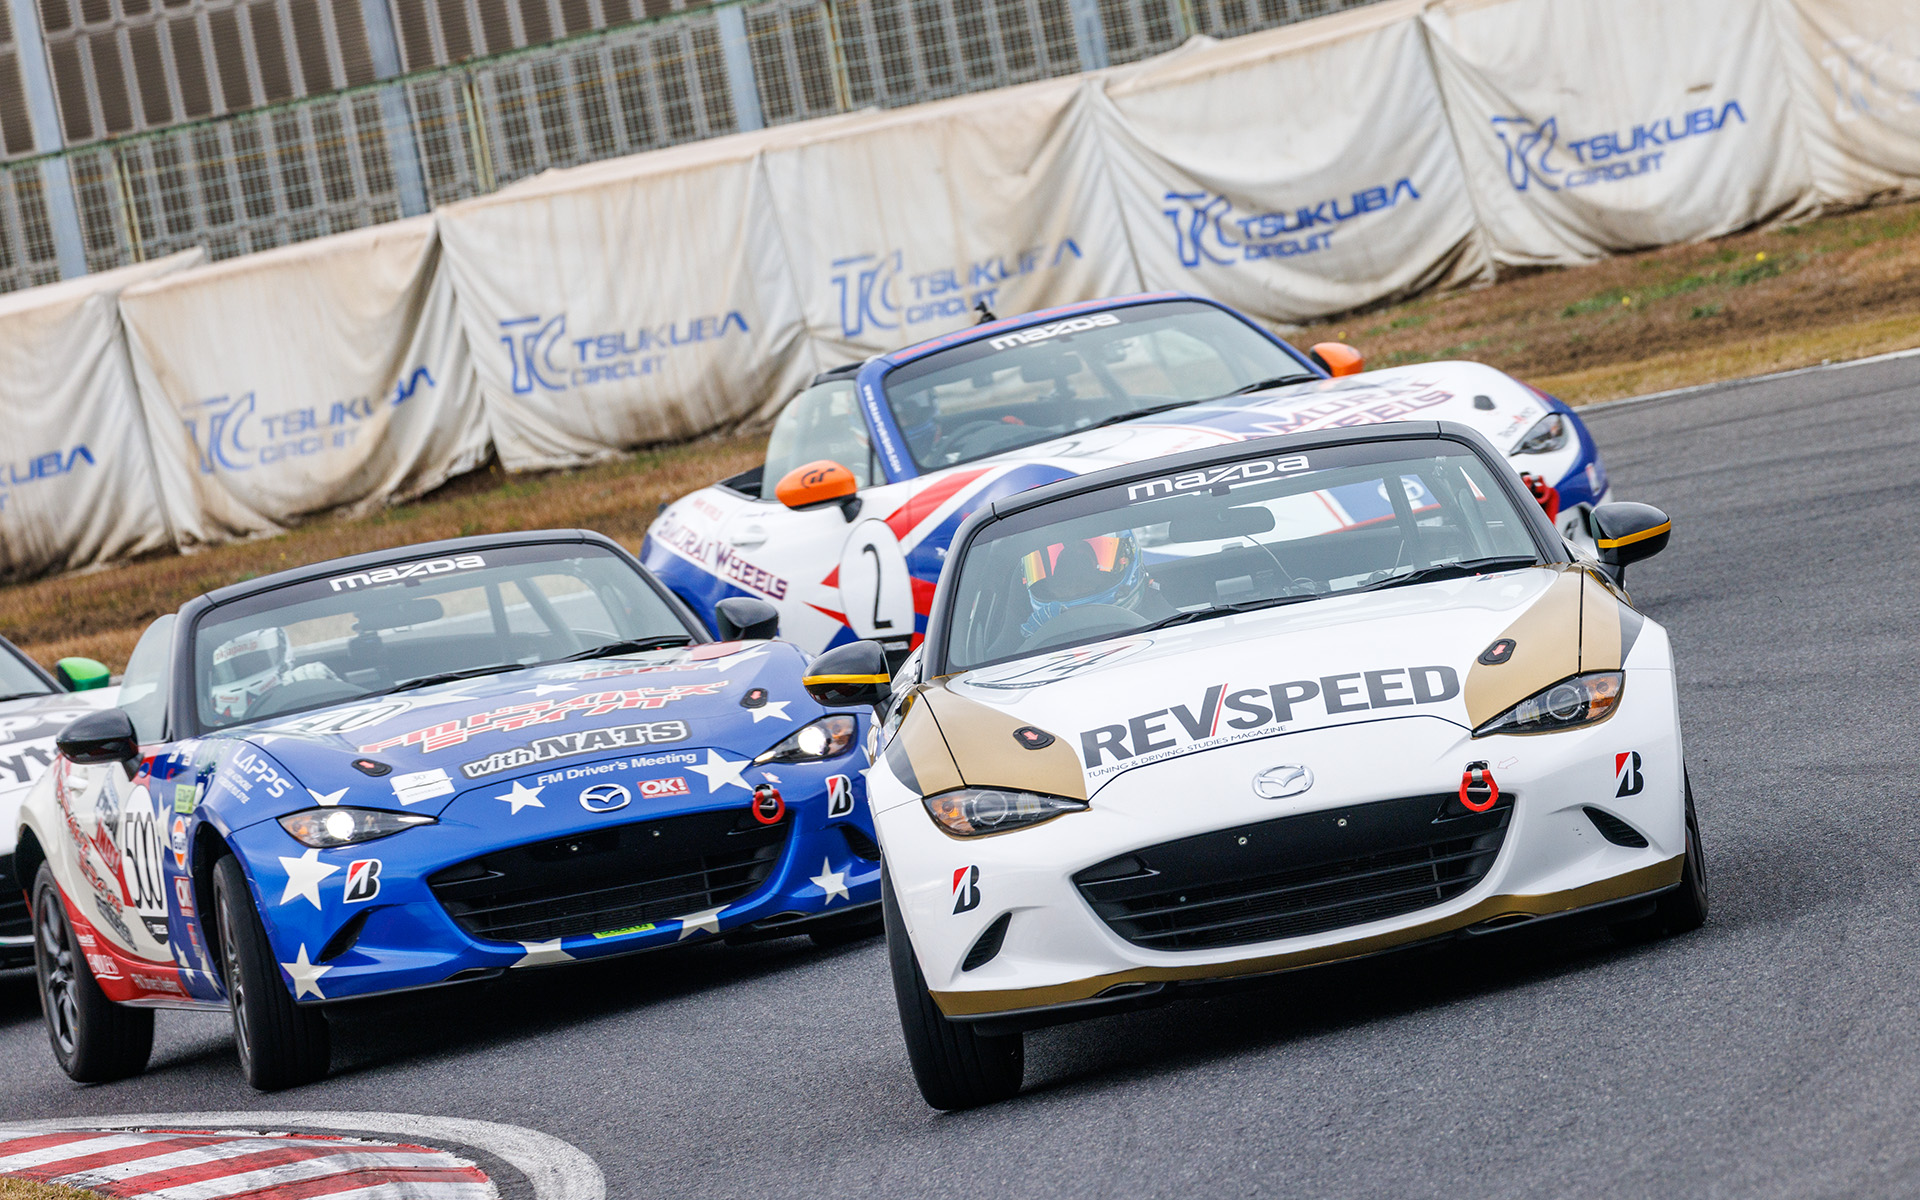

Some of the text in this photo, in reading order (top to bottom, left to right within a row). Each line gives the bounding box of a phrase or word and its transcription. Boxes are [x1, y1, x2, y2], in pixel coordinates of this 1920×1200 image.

[1567, 99, 1747, 164] TSUKUBA
[1564, 150, 1665, 189] CIRCUIT
[1236, 177, 1421, 240] TSUKUBA
[1243, 229, 1335, 262] CIRCUIT
[572, 309, 750, 364] TSUKUBA
[988, 312, 1122, 351] mazda
[571, 354, 667, 388] CIRCUIT
[0, 443, 97, 487] UBA
[1126, 454, 1311, 502] mazda
[328, 554, 487, 593] mazda
[862, 542, 895, 630] 2
[231, 745, 293, 799] LAPPS
[467, 721, 685, 776] with NATS
[537, 752, 698, 787] FM Driver's Meeting
[1087, 724, 1288, 779] TUNING & DRIVING STUDIES MAGAZINE
[640, 777, 688, 795] OK!
[126, 811, 163, 910] 500
